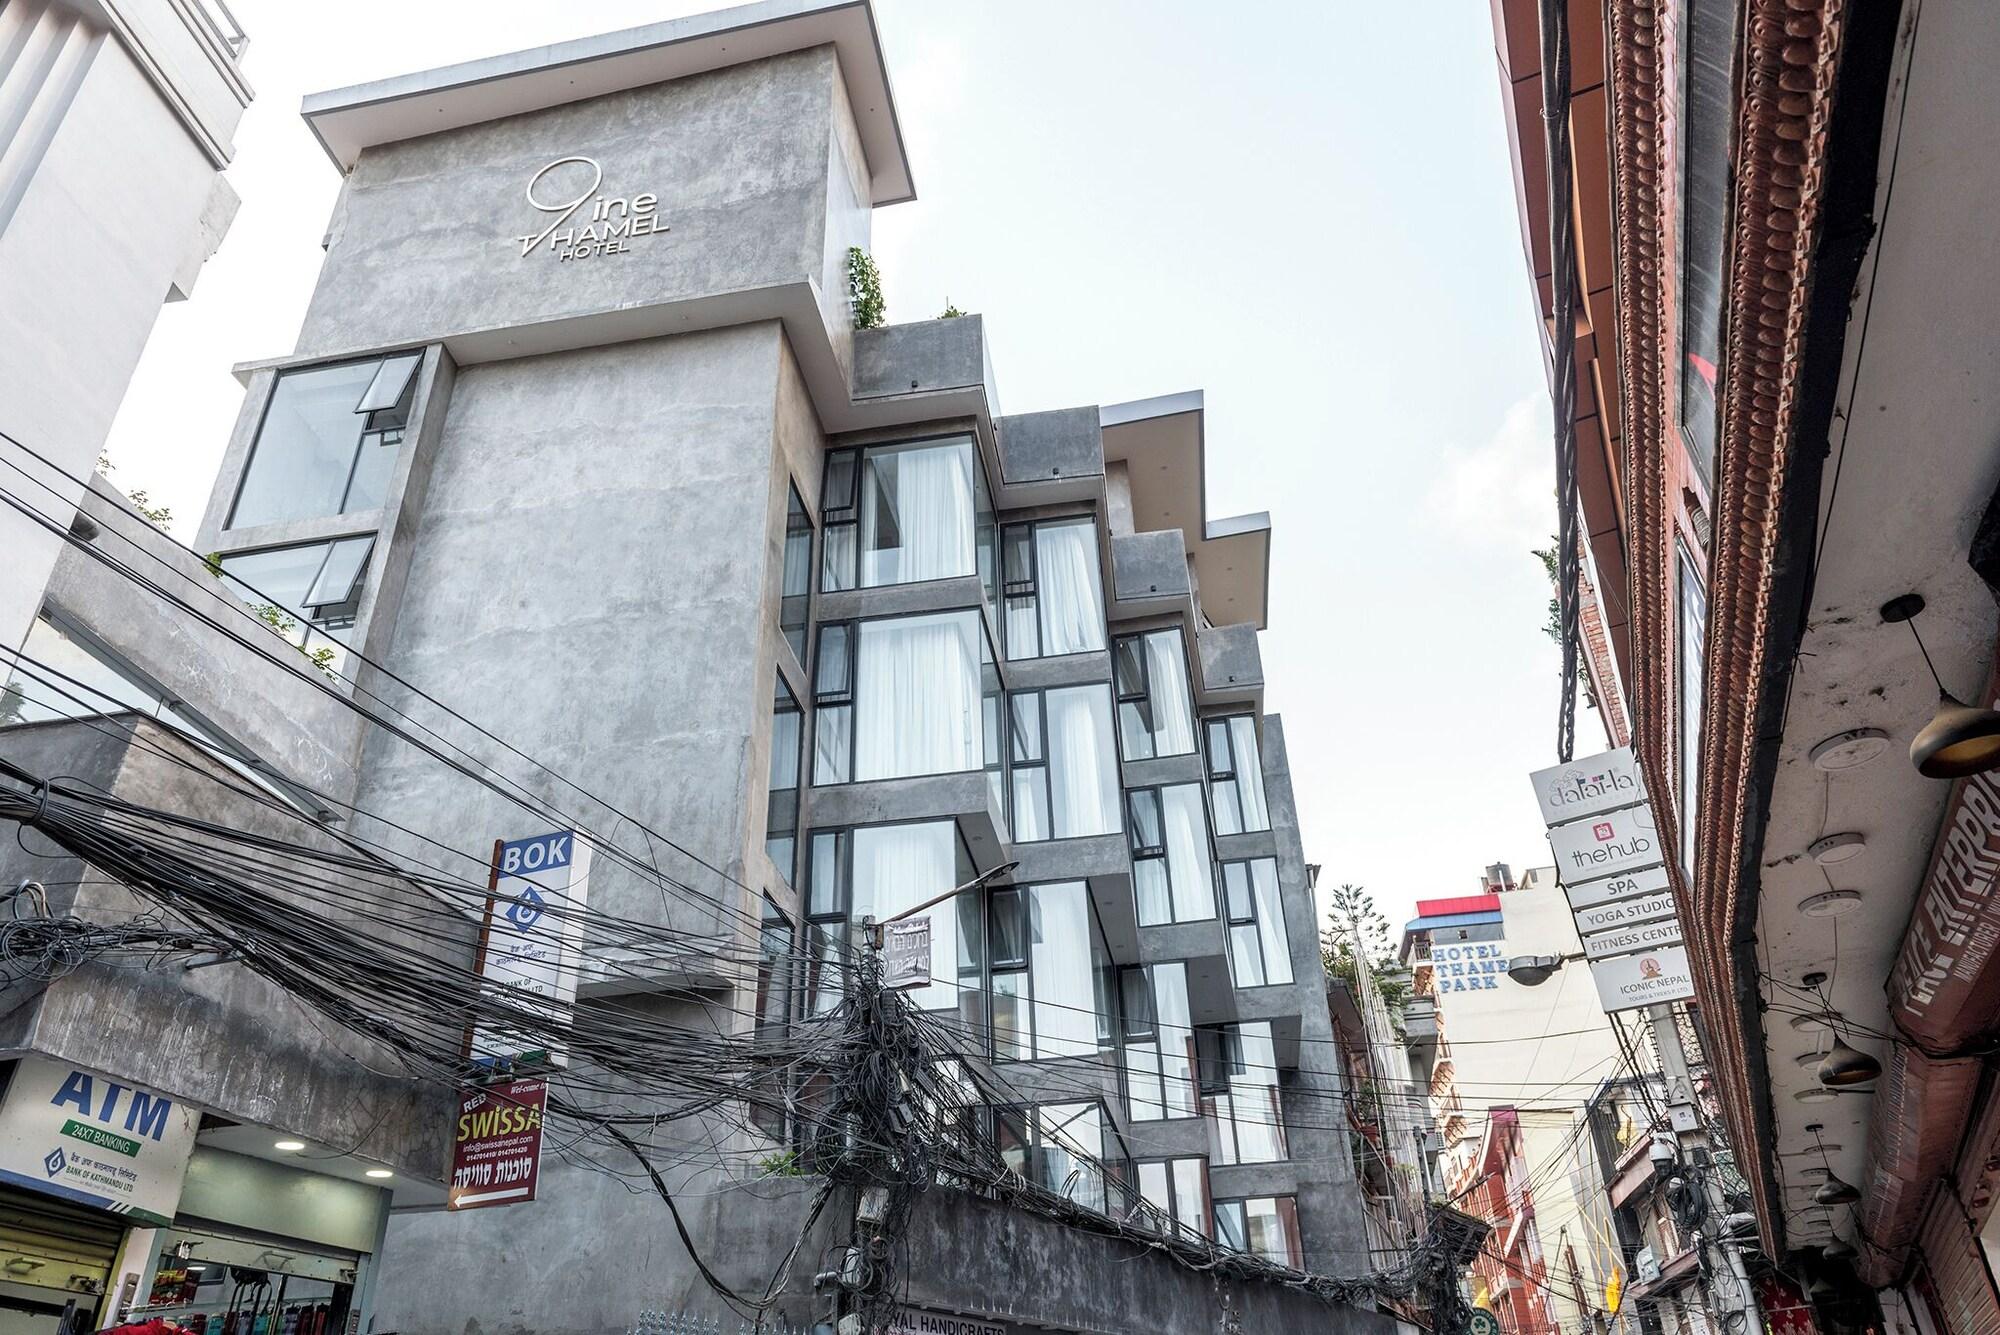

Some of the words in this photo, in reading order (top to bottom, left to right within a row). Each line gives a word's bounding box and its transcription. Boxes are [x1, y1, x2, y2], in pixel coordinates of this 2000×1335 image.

[560, 240, 630, 262] HOTEL
[503, 836, 568, 874] BOK
[1924, 768, 2000, 947] ENTERPRI
[1607, 878, 1639, 895] SPA
[1587, 909, 1625, 925] YOGA
[1591, 933, 1640, 951] FITNESS
[1642, 924, 1682, 941] CENTR
[1432, 944, 1501, 962] HOTEL
[1953, 921, 2000, 984] MANUFACTURER
[1440, 975, 1498, 993] PARK
[1620, 979, 1656, 994] ICONIC
[1656, 975, 1690, 988] NEPAL
[50, 1070, 172, 1142] ATM
[463, 1092, 487, 1113] RED
[94, 1130, 130, 1153] BANKING
[66, 1165, 81, 1177] BANK
[82, 1169, 90, 1178] OF
[91, 1173, 123, 1189] KATHMANDU
[123, 1183, 134, 1192] LTD
